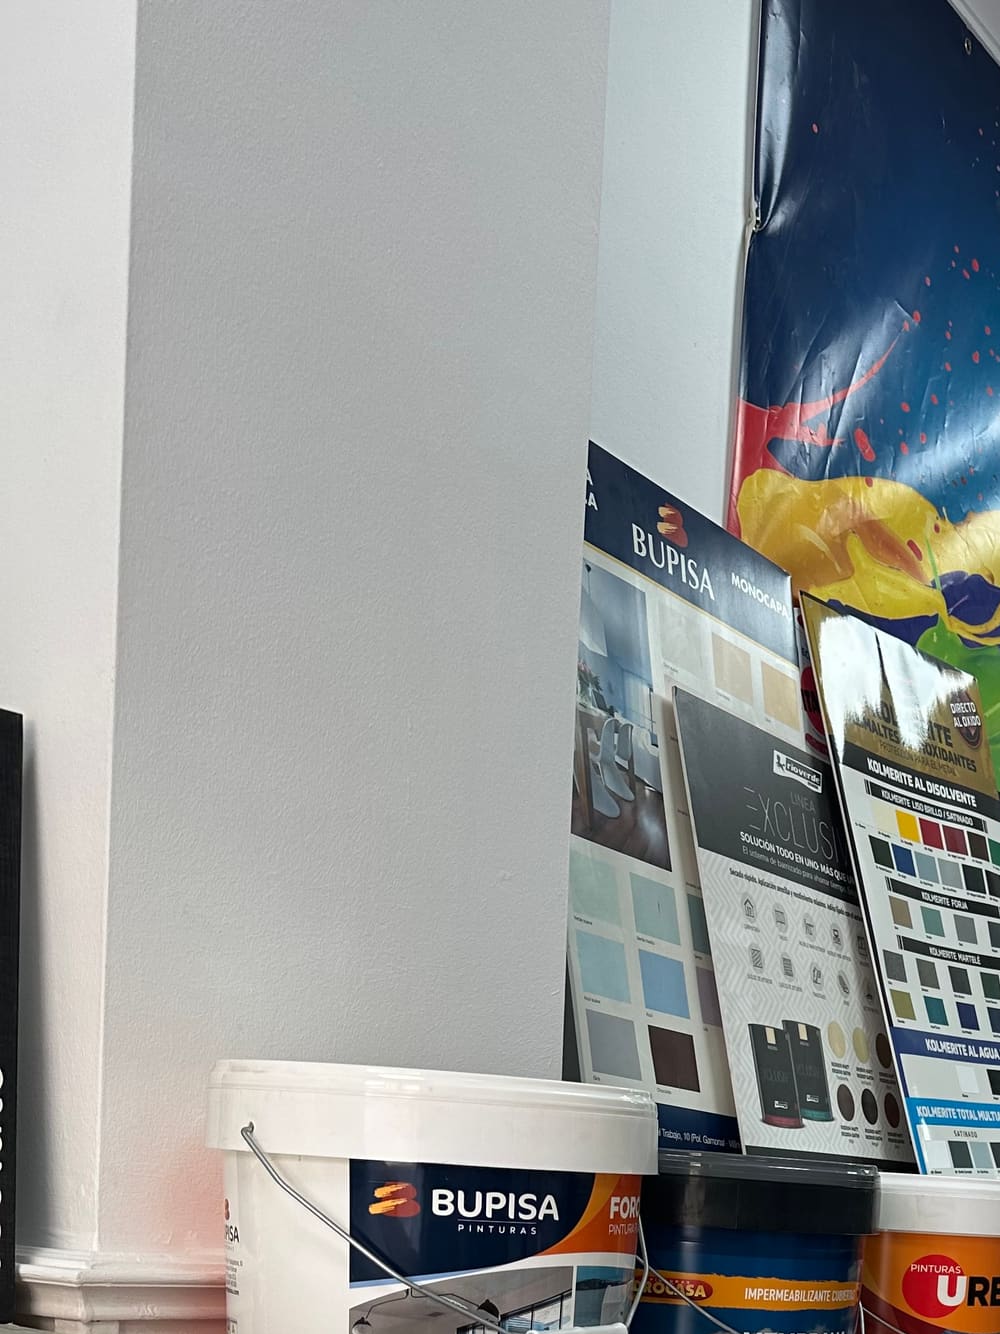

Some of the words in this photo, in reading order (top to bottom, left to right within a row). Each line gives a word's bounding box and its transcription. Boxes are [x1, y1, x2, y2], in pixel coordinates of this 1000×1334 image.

[631, 523, 715, 601] BUPISA
[731, 571, 790, 618] MONOCAPA
[950, 702, 976, 714] DIRECTO
[953, 717, 962, 728] AL
[786, 762, 820, 785] rioverde
[867, 757, 914, 787] KOLMERITE
[914, 776, 926, 792] AL
[926, 780, 977, 807] DISOLVENTE
[881, 790, 911, 808] KOLMERITE
[740, 831, 776, 853] SOLUCIÓN
[775, 845, 795, 861] TODO
[795, 853, 804, 865] EN
[920, 891, 951, 908] KOLMERITE
[928, 946, 958, 961] KOLMERITE
[925, 1038, 968, 1057] KOLMERITE
[968, 1046, 978, 1057] AL
[978, 1046, 1000, 1060] AGUA
[916, 1105, 955, 1121] KOLMERITE
[955, 1108, 977, 1121] TOTAL
[431, 1188, 560, 1221] BUPISA
[457, 1223, 537, 1236] PINTURAS
[910, 1263, 962, 1275] PINTURAS
[744, 1286, 831, 1302] IMPERMEABILIZANTE
